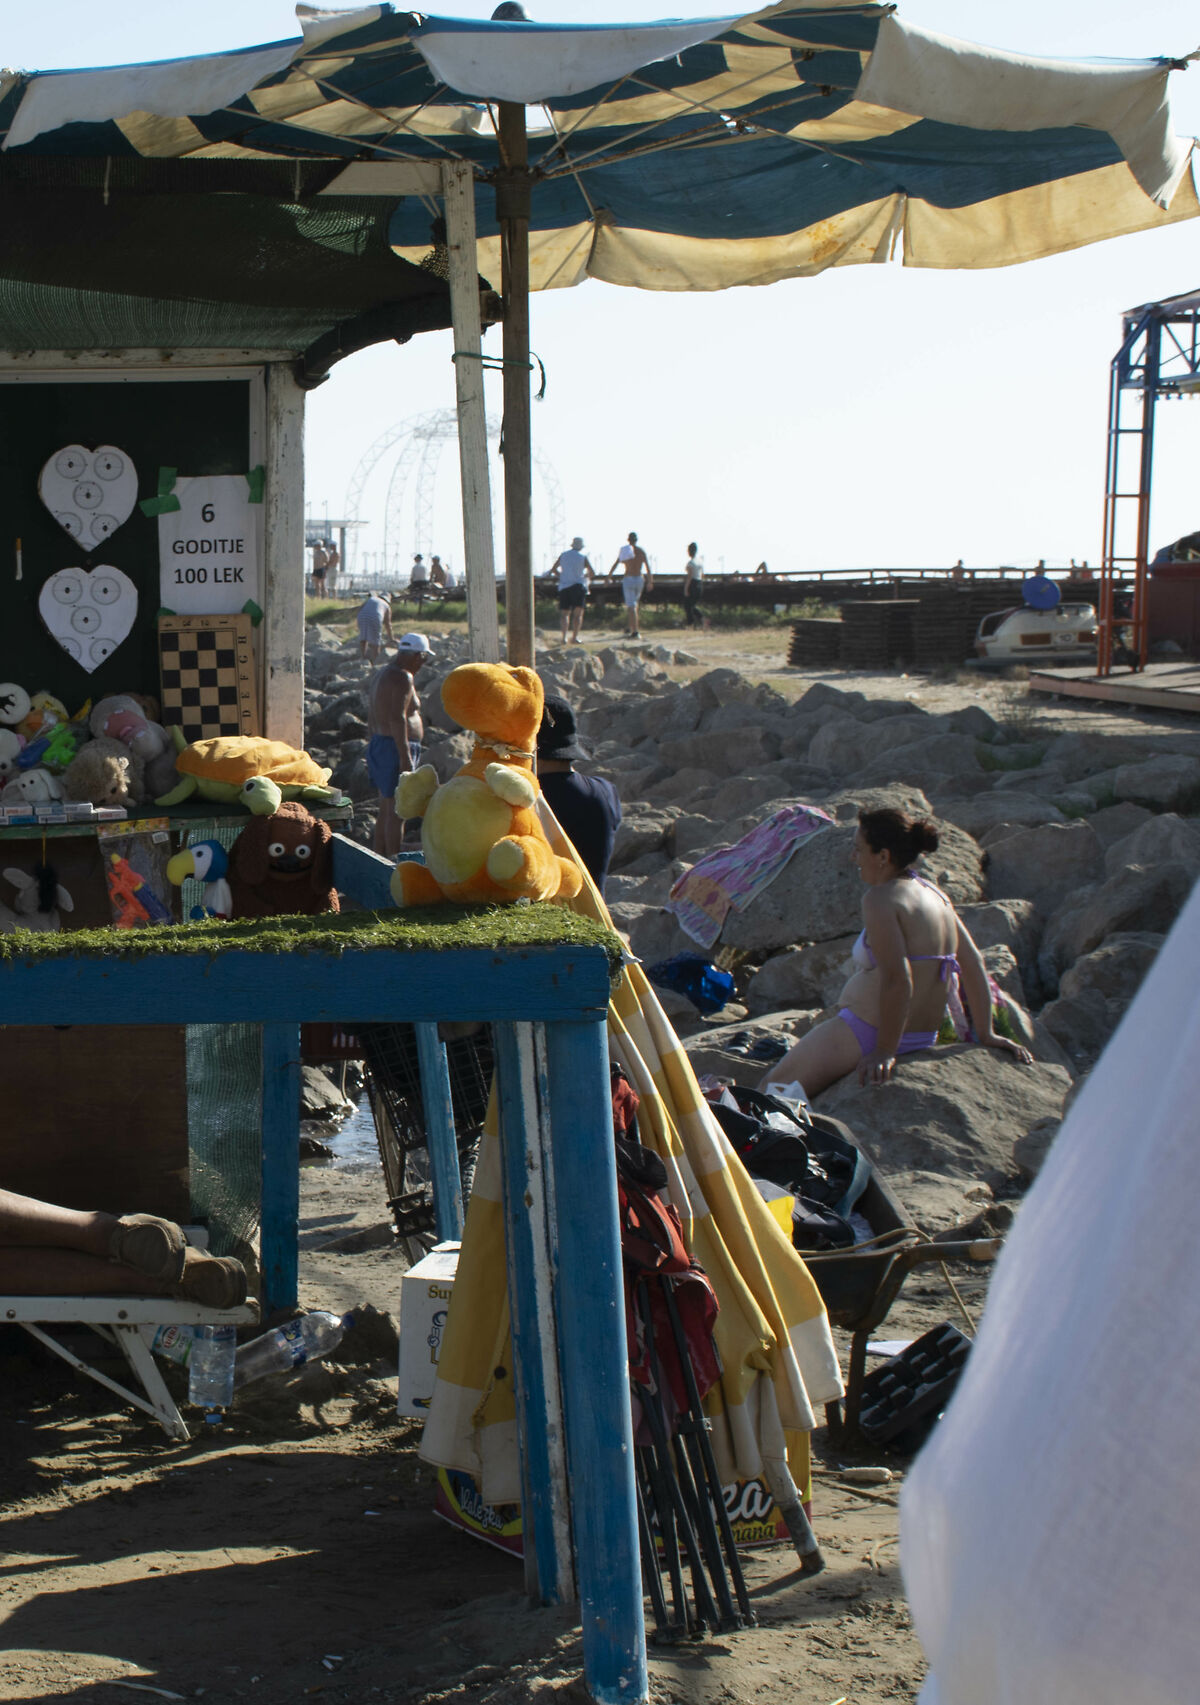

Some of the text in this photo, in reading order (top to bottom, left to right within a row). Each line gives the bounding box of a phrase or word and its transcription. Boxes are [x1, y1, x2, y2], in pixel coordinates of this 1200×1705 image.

[201, 503, 216, 523] 6
[172, 538, 245, 555] GODITJE
[174, 567, 245, 584] 100 LEK
